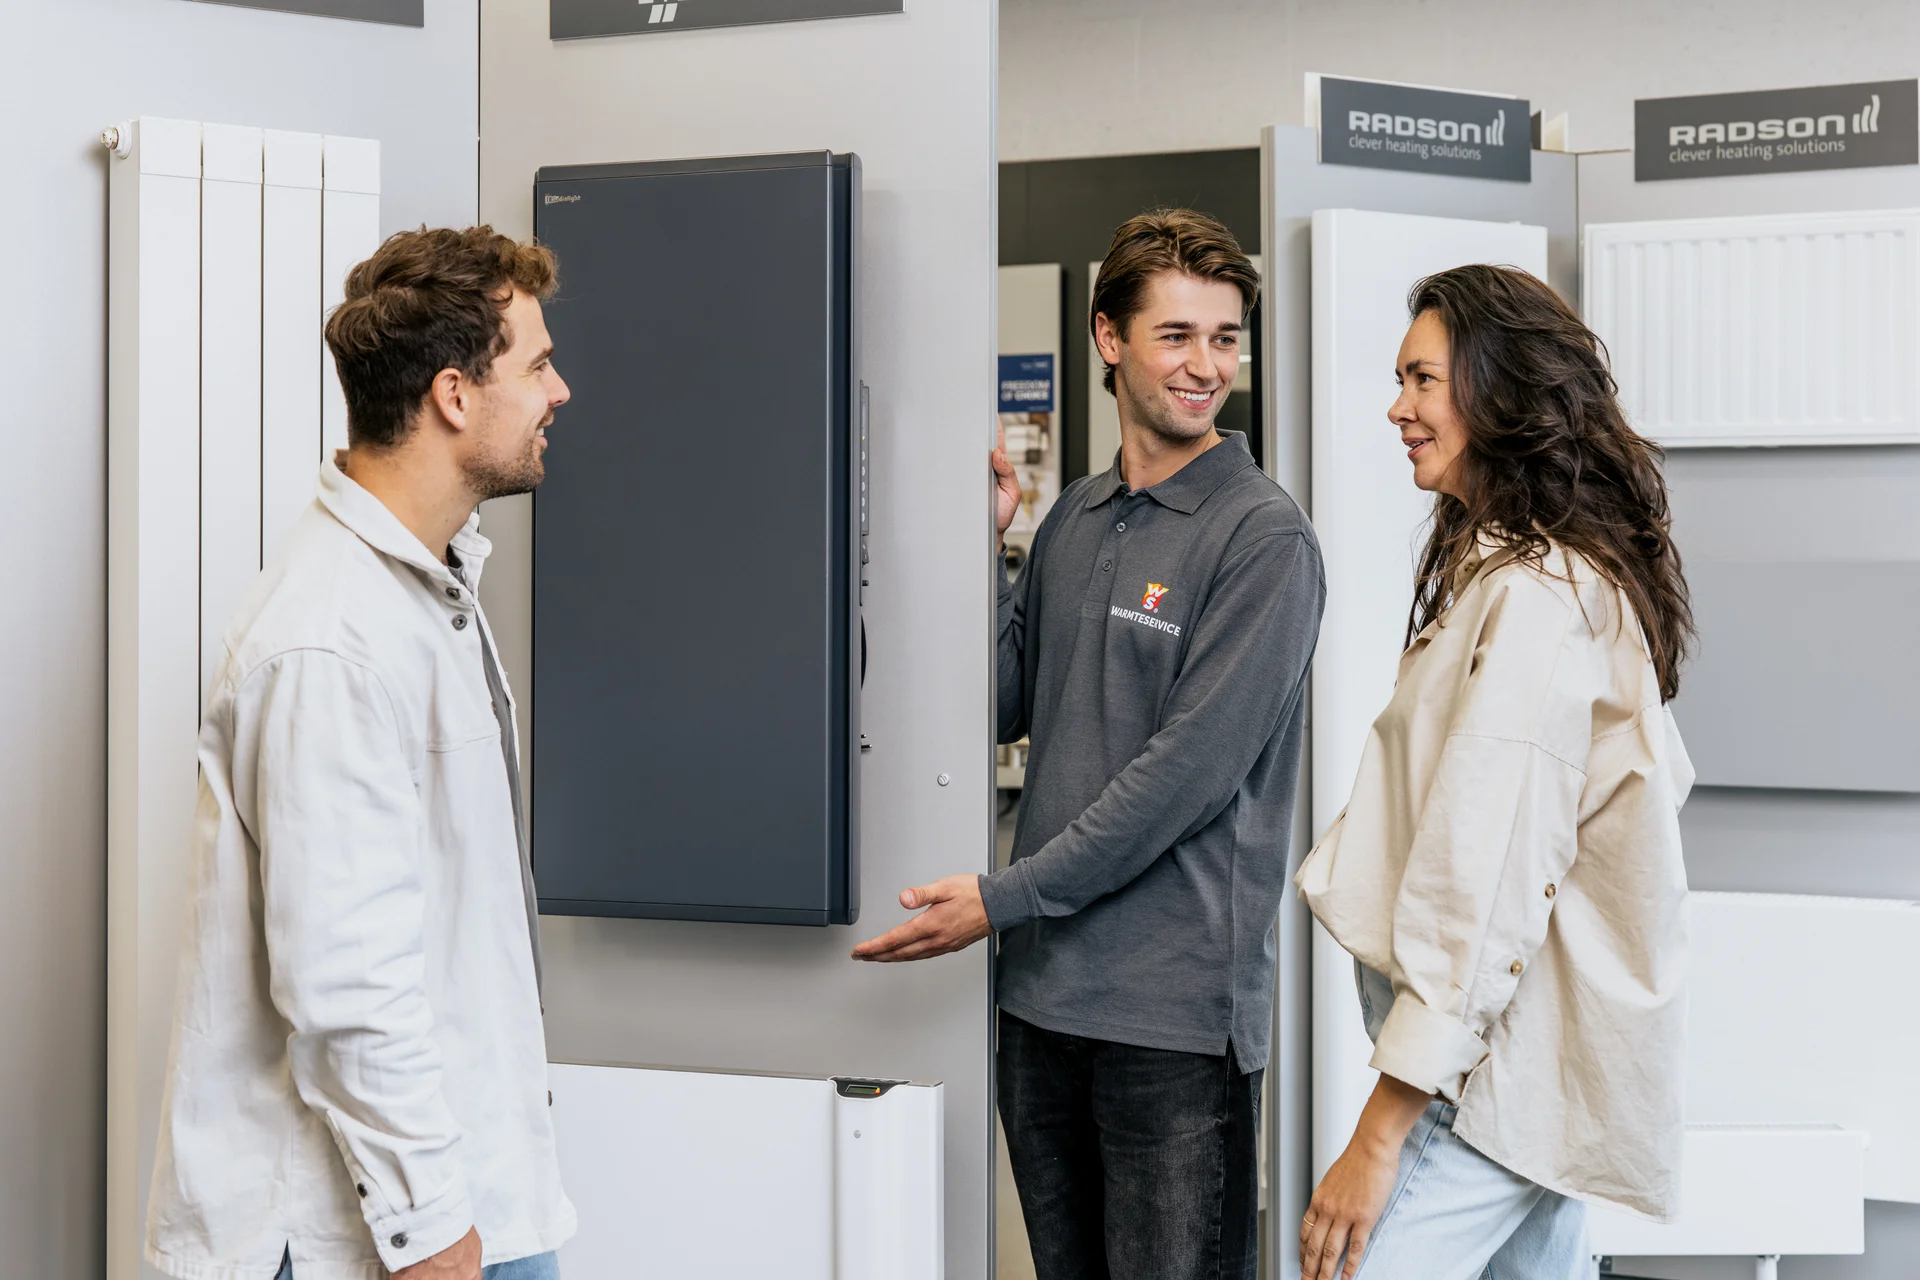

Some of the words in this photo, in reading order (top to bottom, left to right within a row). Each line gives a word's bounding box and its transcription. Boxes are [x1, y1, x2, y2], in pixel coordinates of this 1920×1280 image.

[1349, 110, 1482, 144] RADSON
[1669, 114, 1846, 147] RADSON
[1349, 134, 1383, 150] clever
[1386, 137, 1429, 160] heating
[1431, 143, 1482, 161] solutions
[1669, 147, 1712, 163] clever
[1716, 143, 1773, 161] heating
[1776, 138, 1846, 156] solutions
